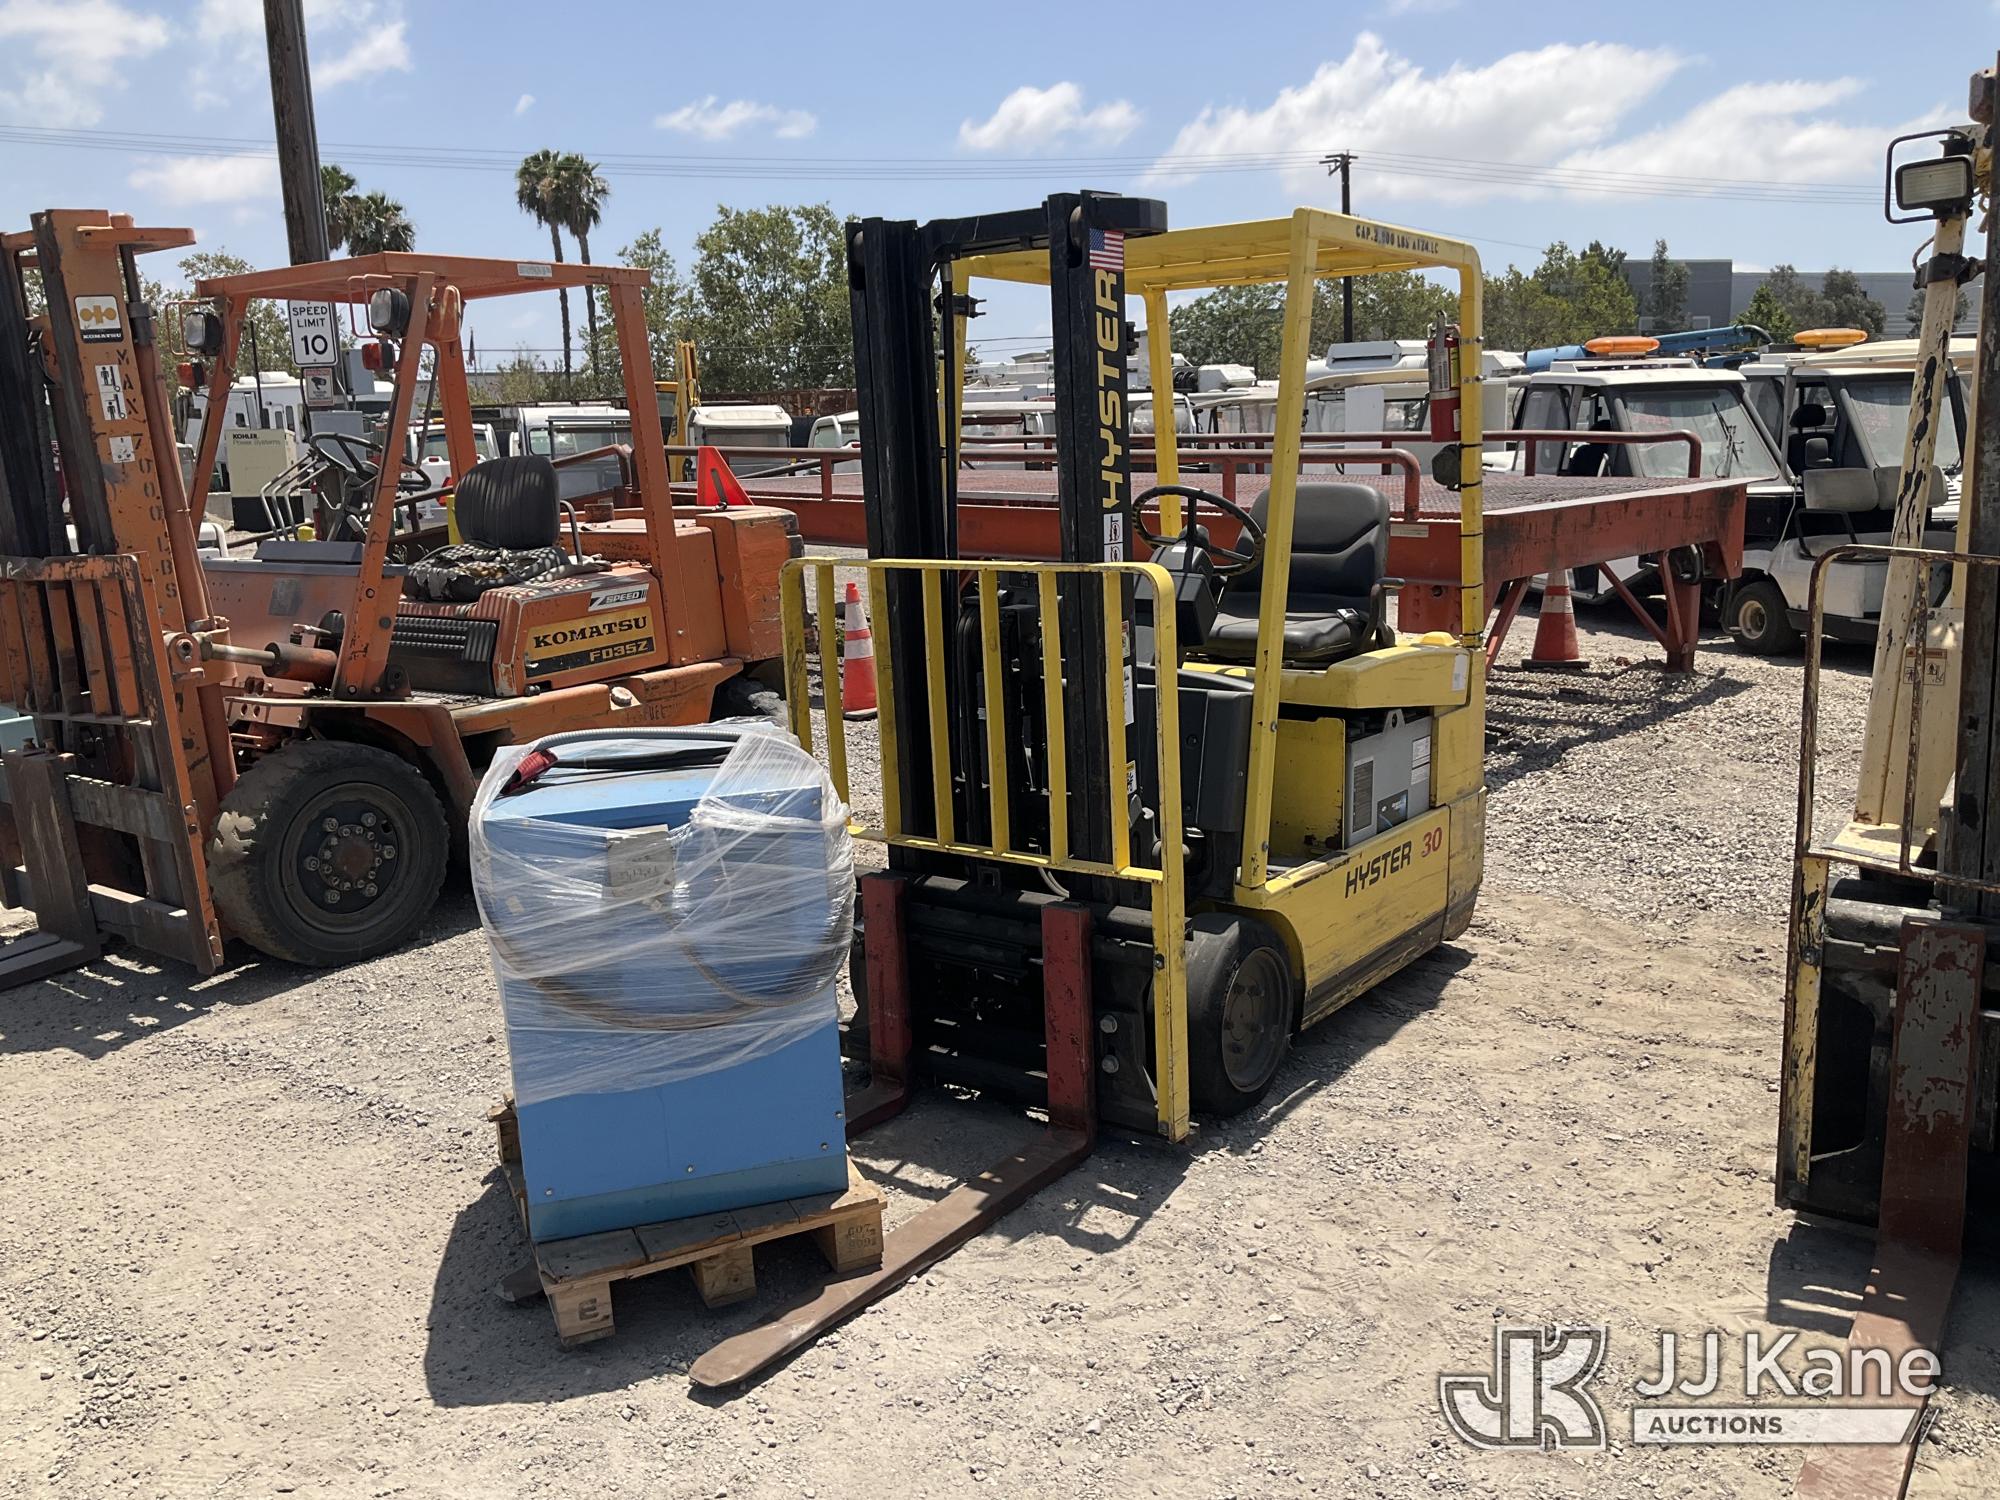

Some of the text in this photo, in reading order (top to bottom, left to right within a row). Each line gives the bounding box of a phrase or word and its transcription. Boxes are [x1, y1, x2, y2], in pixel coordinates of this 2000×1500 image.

[292, 306, 328, 316] SPEED
[297, 318, 326, 328] LIMIT
[82, 332, 122, 340] KOMATSU
[301, 334, 328, 355] 10
[1094, 268, 1124, 509] HYSTER
[533, 616, 647, 648] KOMATSU
[590, 640, 649, 662] FD35Z
[1344, 826, 1443, 899] HYSTER 30
